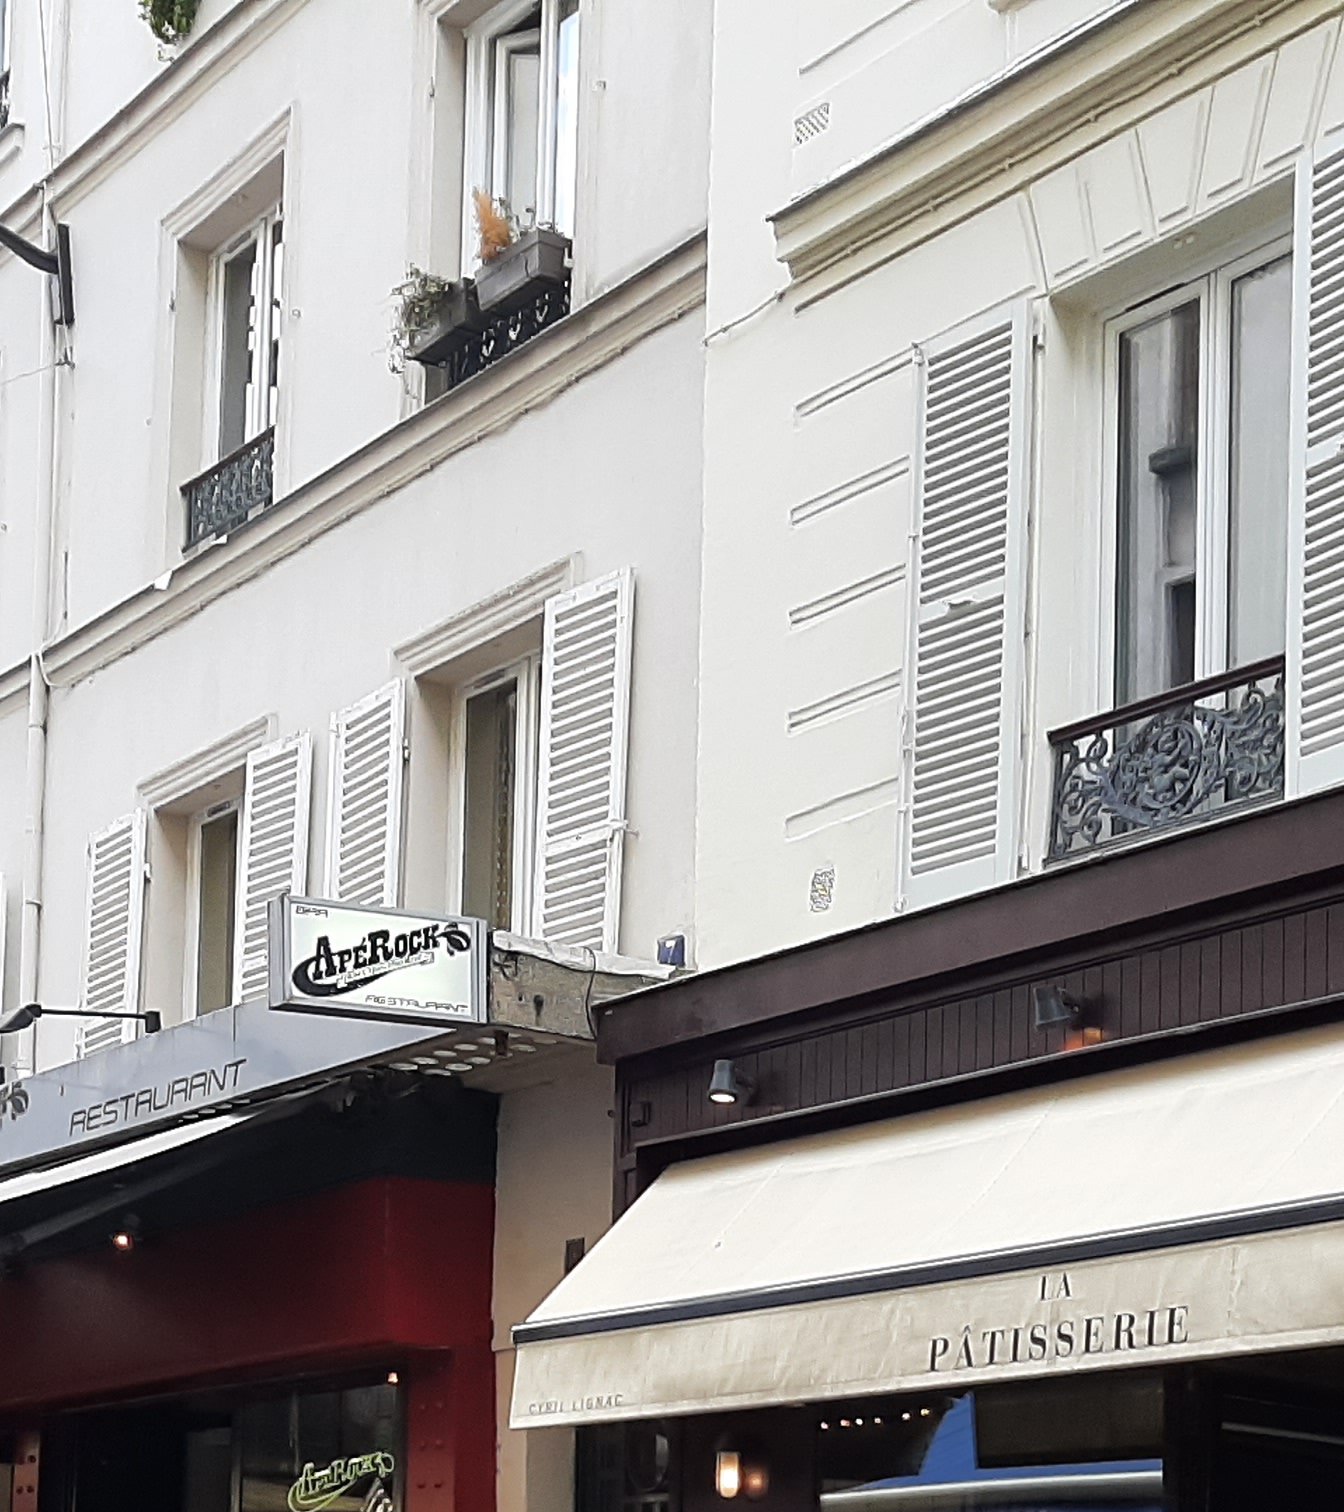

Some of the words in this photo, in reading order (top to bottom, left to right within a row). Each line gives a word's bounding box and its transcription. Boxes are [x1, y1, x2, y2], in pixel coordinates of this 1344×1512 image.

[665, 939, 677, 964] 7
[69, 1058, 248, 1137] RESTAURANT
[1039, 1271, 1073, 1301] LA
[927, 1305, 1190, 1373] PÂTISSERIE
[528, 1401, 565, 1416] CYRIL
[571, 1394, 624, 1412] LIGNAC
